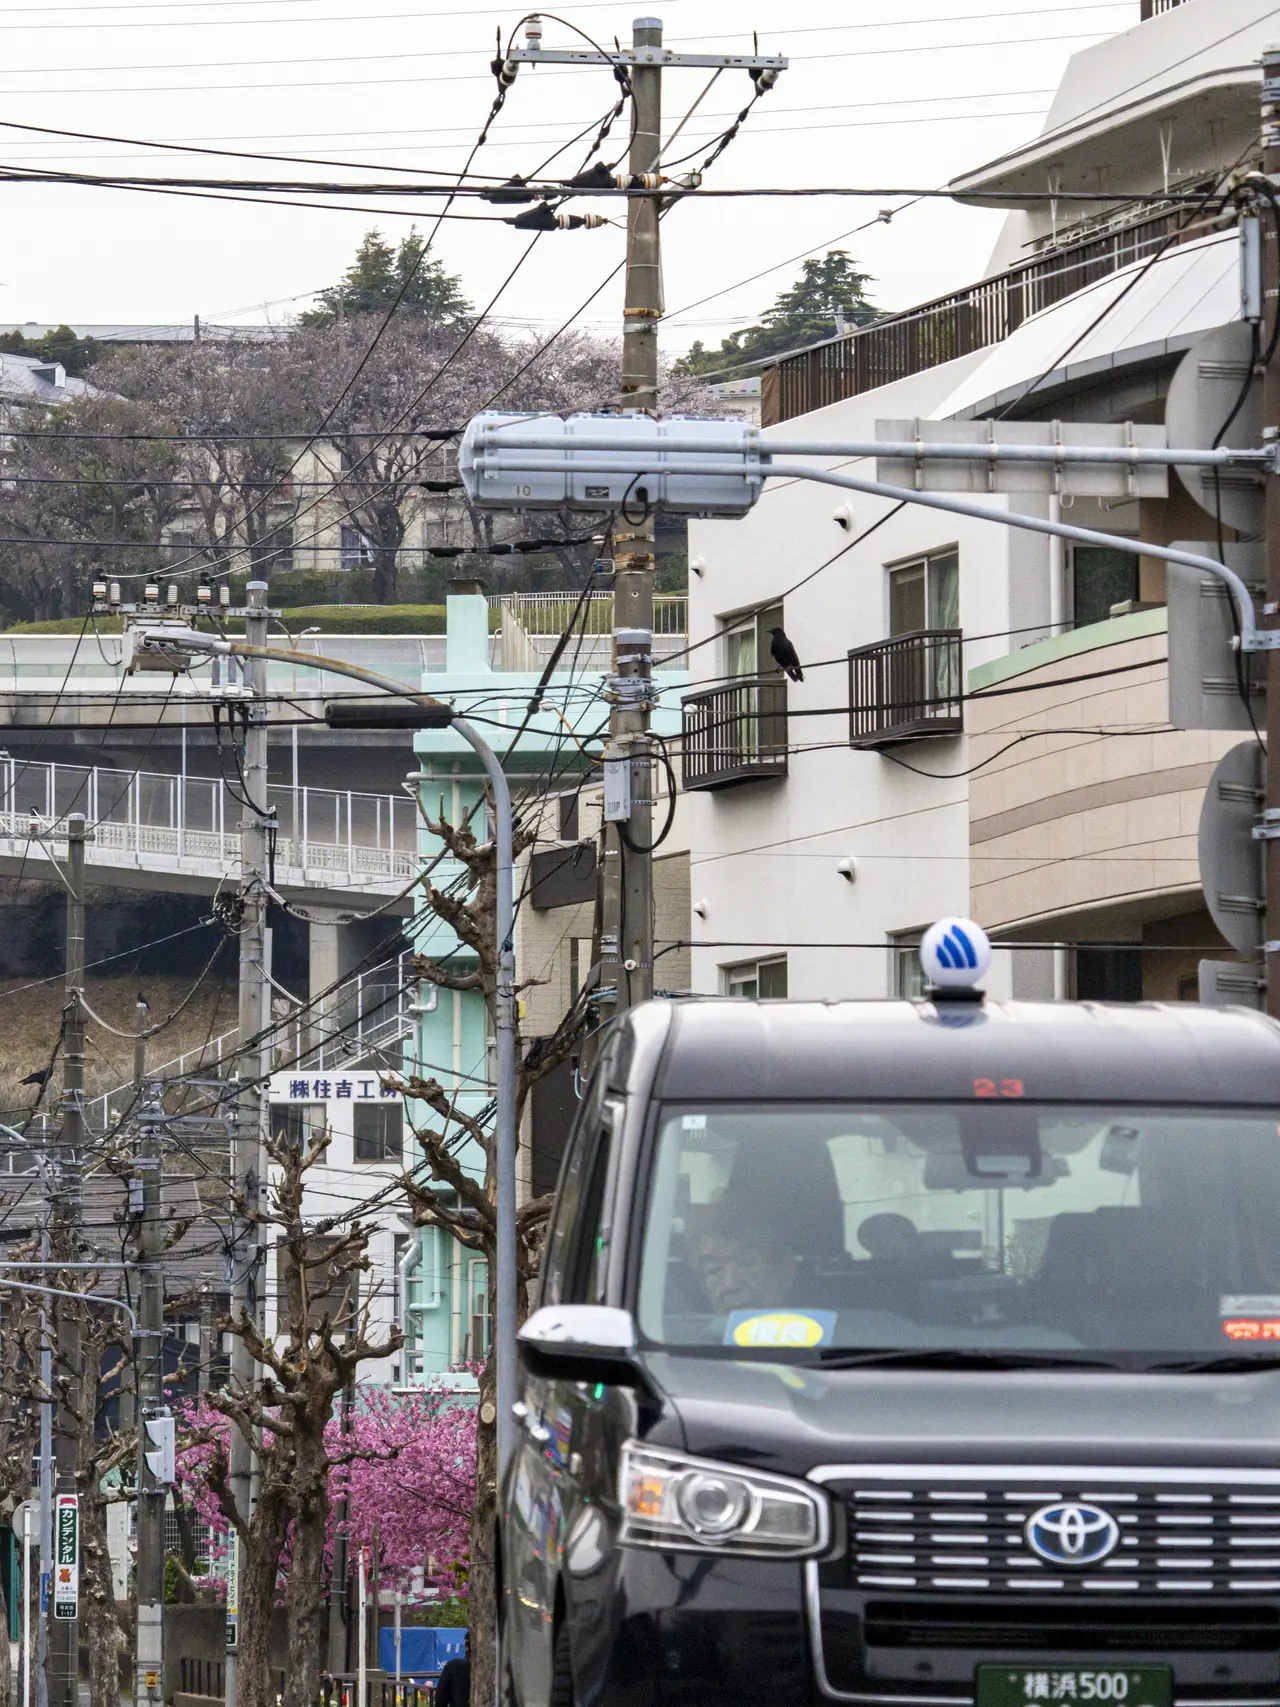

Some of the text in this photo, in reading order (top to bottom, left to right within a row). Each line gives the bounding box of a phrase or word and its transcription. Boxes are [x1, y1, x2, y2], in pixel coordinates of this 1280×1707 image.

[61, 1509, 74, 1563] カンデンタル
